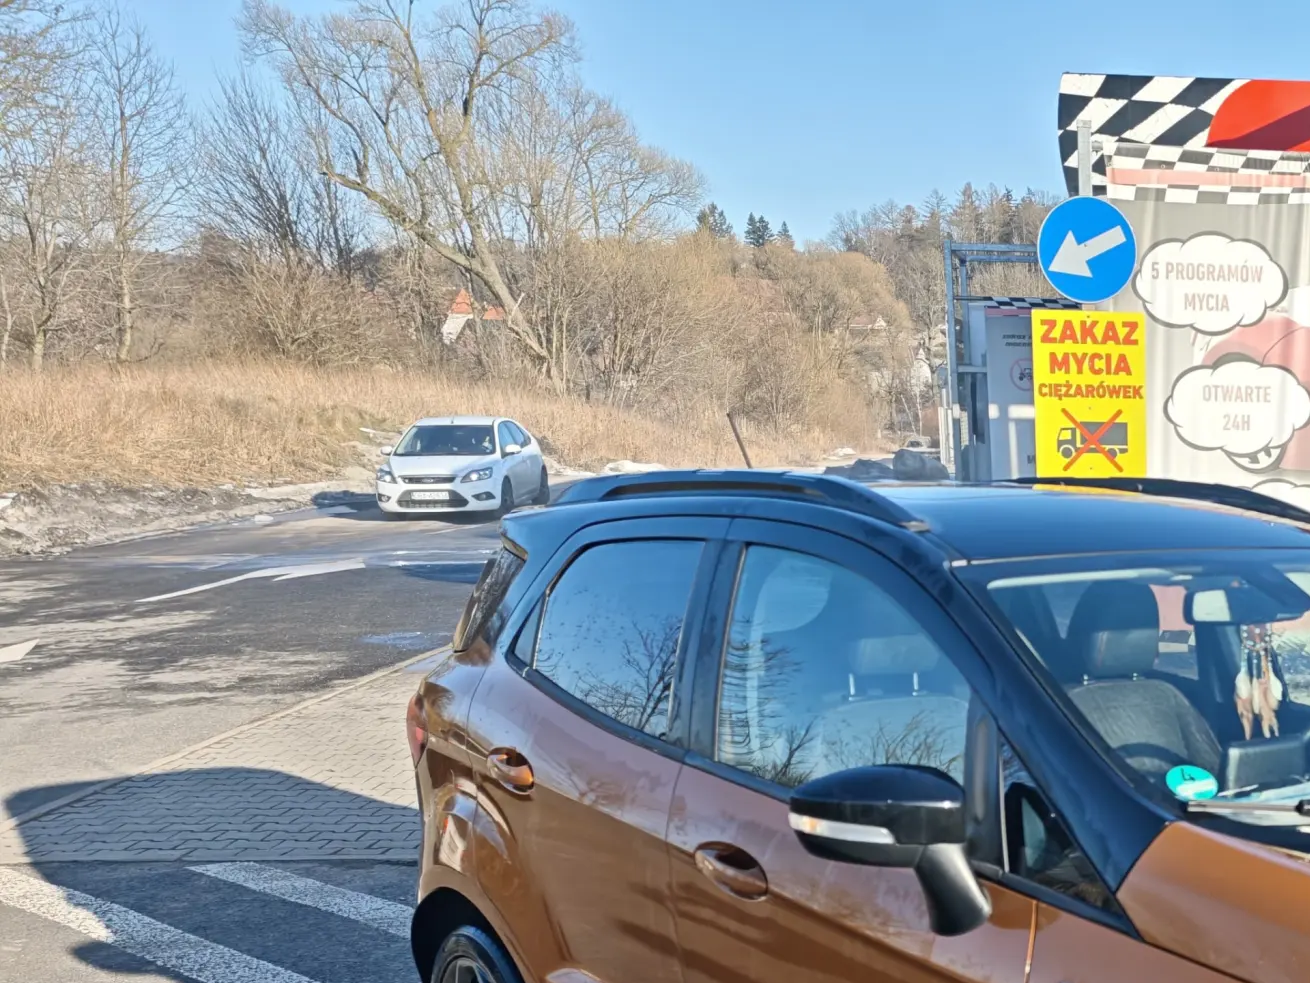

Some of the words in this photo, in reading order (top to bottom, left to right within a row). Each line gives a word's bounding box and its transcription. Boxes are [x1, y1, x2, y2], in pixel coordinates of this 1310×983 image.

[1151, 261, 1160, 280] 5
[1165, 259, 1263, 283] PROGRAMÓW
[1184, 292, 1230, 312] MYCIA
[1040, 319, 1139, 345] ZAKAZ
[1049, 352, 1132, 376] MYCIA
[1038, 380, 1144, 401] CIĘŻARÓWEK
[1202, 384, 1271, 403] OTWARTE
[1222, 414, 1251, 431] 24H
